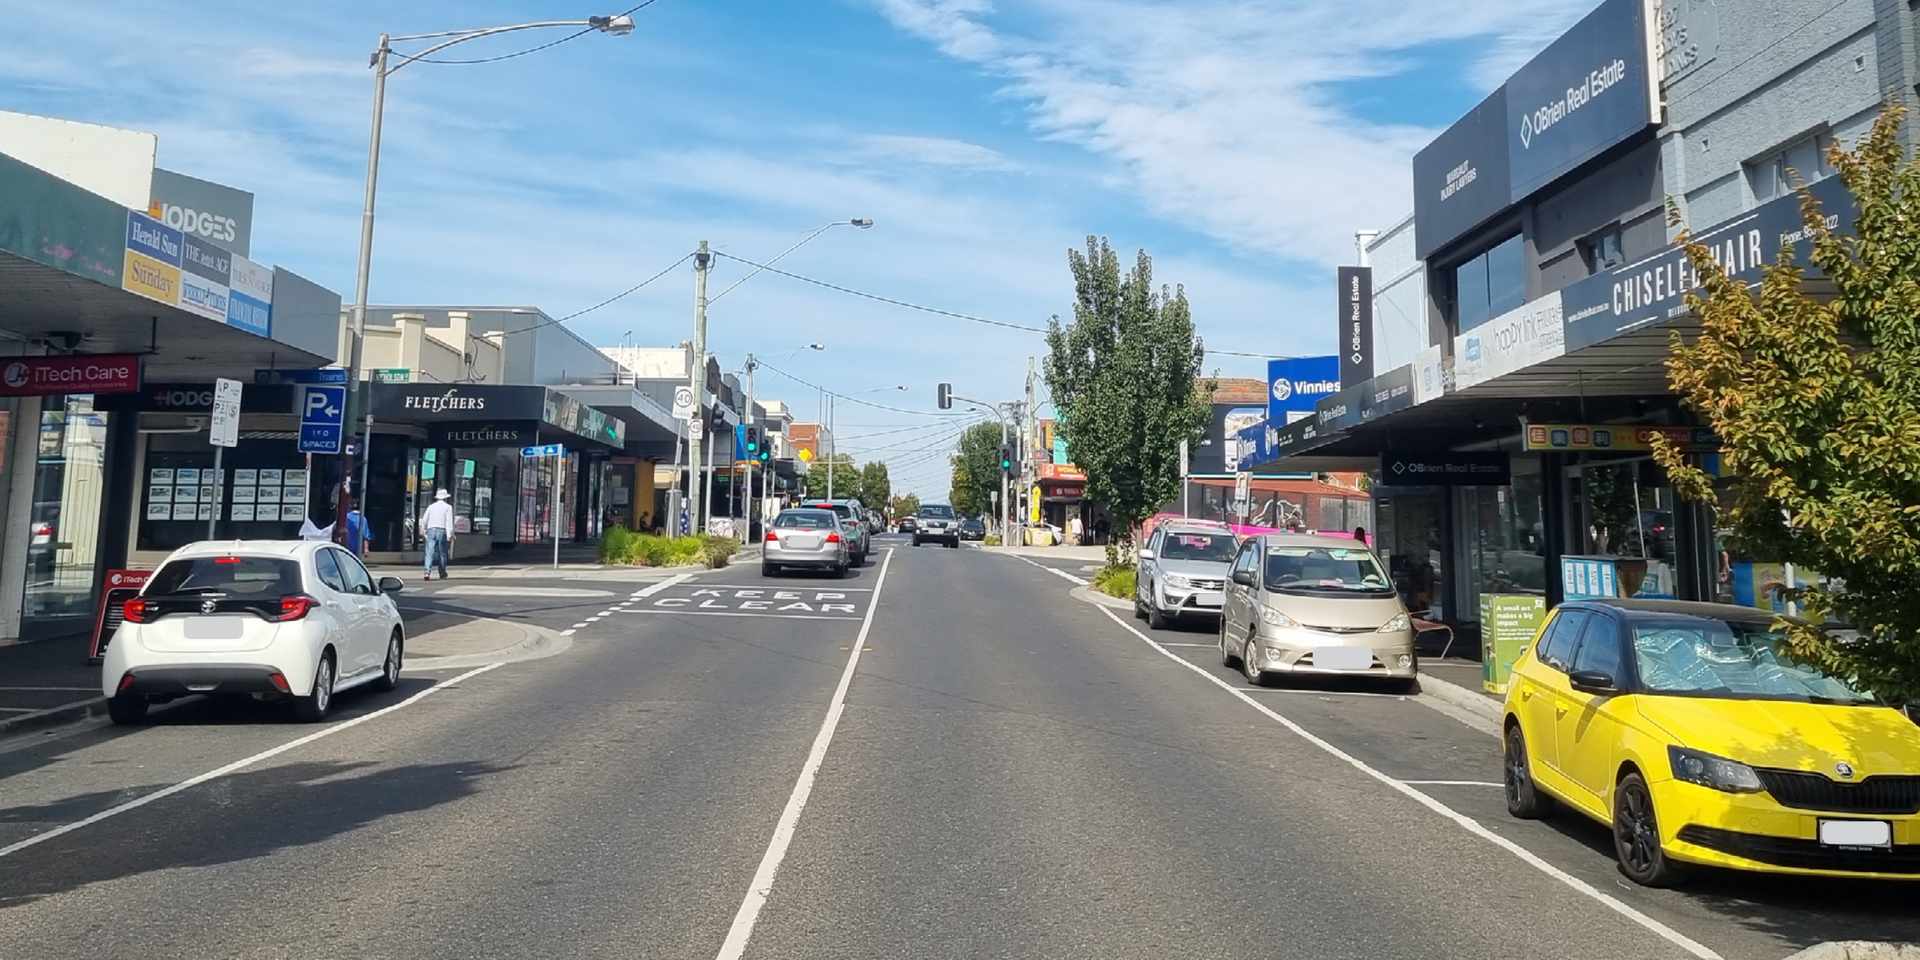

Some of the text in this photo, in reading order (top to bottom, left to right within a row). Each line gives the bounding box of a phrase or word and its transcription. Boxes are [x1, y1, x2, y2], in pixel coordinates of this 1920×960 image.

[1534, 59, 1625, 135] OBrien Real Estate
[148, 201, 236, 242] HODGES
[132, 221, 178, 257] Herald Sun
[185, 243, 229, 275] THE AGE
[1710, 229, 1762, 278] HAIR
[131, 259, 173, 298] Sunday
[1351, 275, 1361, 351] OBrien Real Estate
[35, 365, 129, 382] iTech Care
[319, 372, 344, 382] Trains
[1295, 381, 1341, 395] Vinnies
[154, 390, 213, 406] HODG
[306, 392, 328, 417] P
[405, 395, 485, 413] FLETCHERS
[677, 394, 690, 403] 40
[302, 440, 336, 449] SPACES
[447, 431, 518, 442] FLETCHERS
[1408, 463, 1501, 473] OBrien Real Estate
[691, 588, 846, 601] KEEP
[653, 598, 856, 613] CLEAR
[1523, 612, 1533, 620] big
